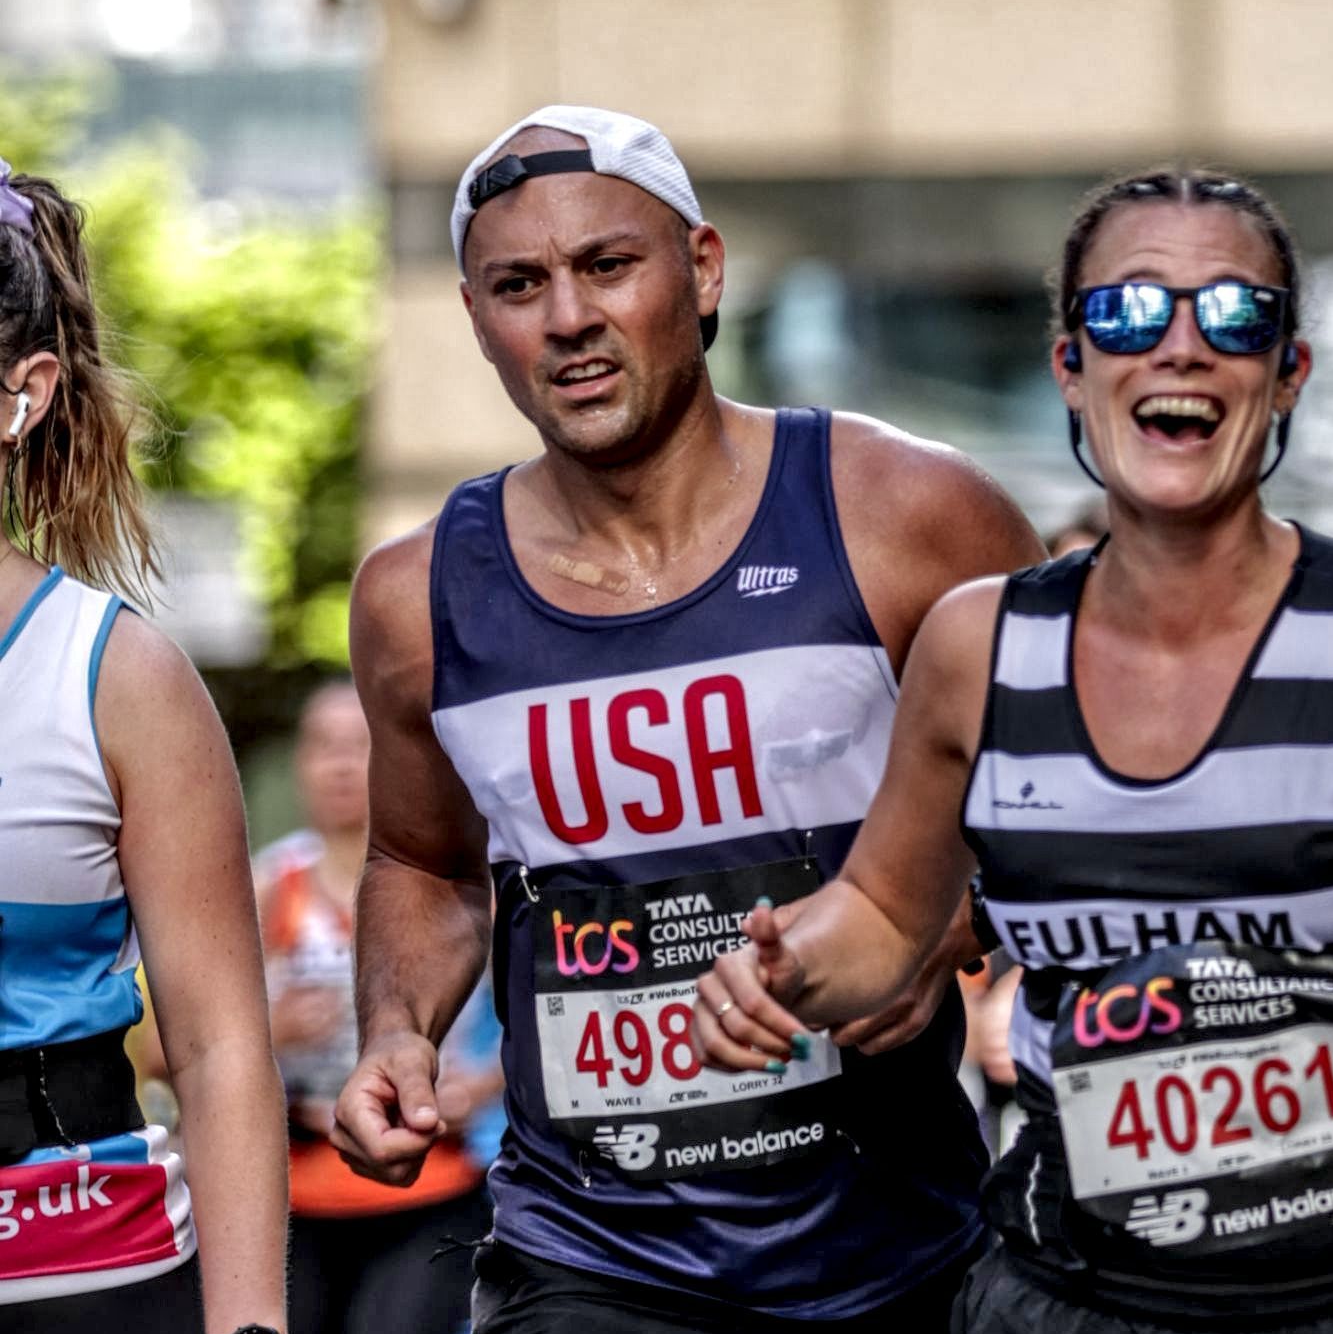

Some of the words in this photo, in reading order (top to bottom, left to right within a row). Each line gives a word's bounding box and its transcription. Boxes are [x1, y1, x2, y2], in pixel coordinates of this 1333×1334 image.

[527, 673, 765, 846] USA
[645, 893, 713, 918] TATA
[552, 909, 640, 976] tcs
[650, 912, 752, 944] CONSULT
[1004, 910, 1296, 962] FULHAM
[1185, 956, 1256, 980] TATA
[649, 986, 698, 1000] #WeRunT
[1073, 976, 1183, 1048] tcs
[1193, 995, 1296, 1028] SERVICES
[575, 1002, 702, 1089] 498
[605, 1097, 635, 1108] WAVE
[732, 1078, 768, 1093] LORRY
[665, 1142, 717, 1168] new
[721, 1122, 825, 1160] balance
[1212, 1203, 1268, 1237] new
